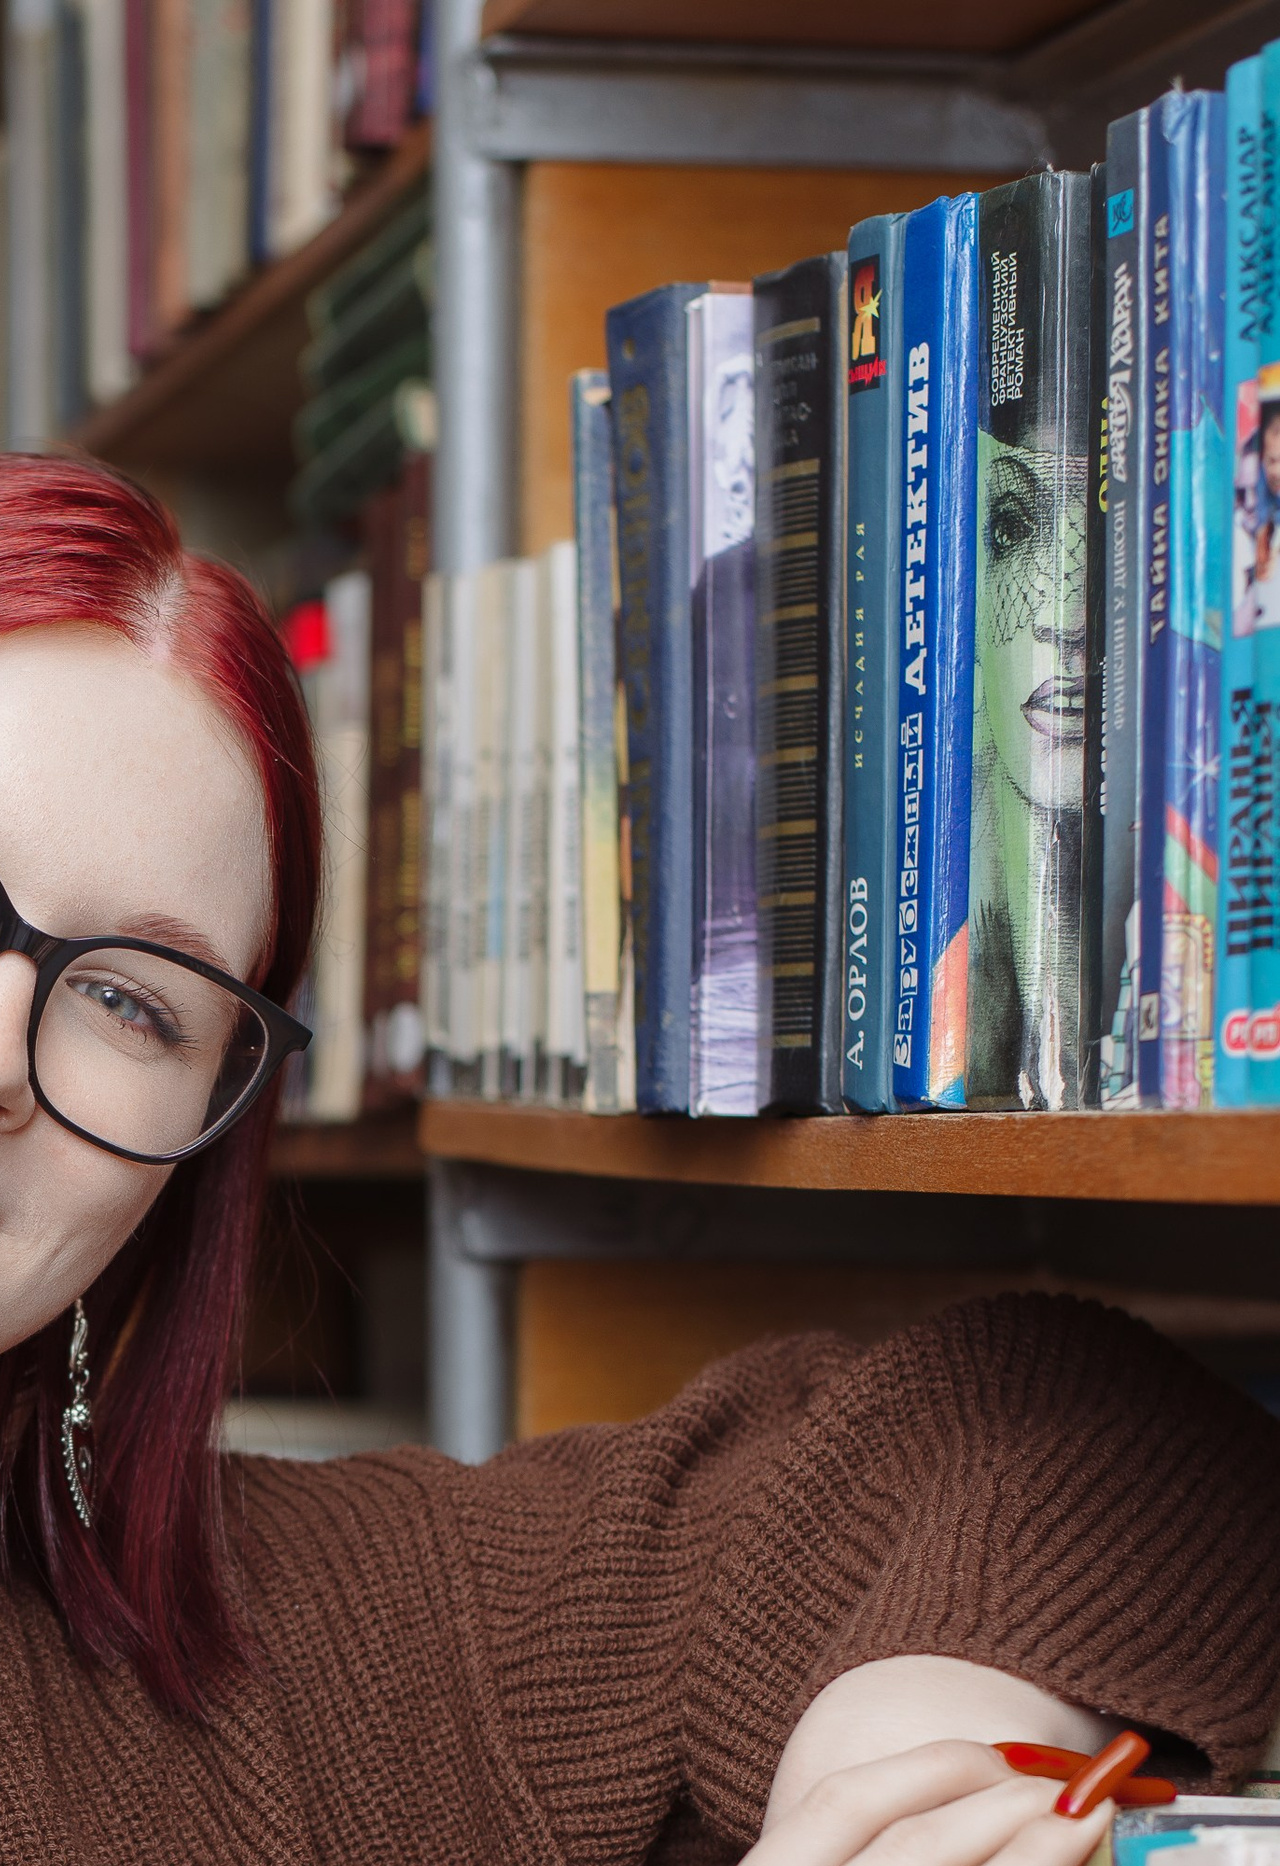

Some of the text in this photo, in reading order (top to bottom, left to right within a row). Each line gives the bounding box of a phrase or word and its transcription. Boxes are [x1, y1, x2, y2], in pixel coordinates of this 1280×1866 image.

[991, 251, 1000, 406] СОВРЕМЕННЫЙ
[999, 258, 1010, 404] ФРАНЦУЗСКИЙ
[1006, 252, 1017, 400] ДЕТЕКТИВНЫЙ
[1014, 328, 1025, 400] РОМАН
[1150, 213, 1169, 644] ТАЙНА ЗНАКА КИТА
[905, 342, 930, 695] ДЕТЕКТИВ
[1113, 500, 1126, 589] ДИКСОН
[853, 522, 866, 768] ИСЧАДИЯ РАЯ
[1113, 617, 1126, 731] ФРАНКЛИН
[1227, 687, 1252, 957] ПИРАНЬЯ
[846, 877, 868, 1070] А. ОРЛОВ
